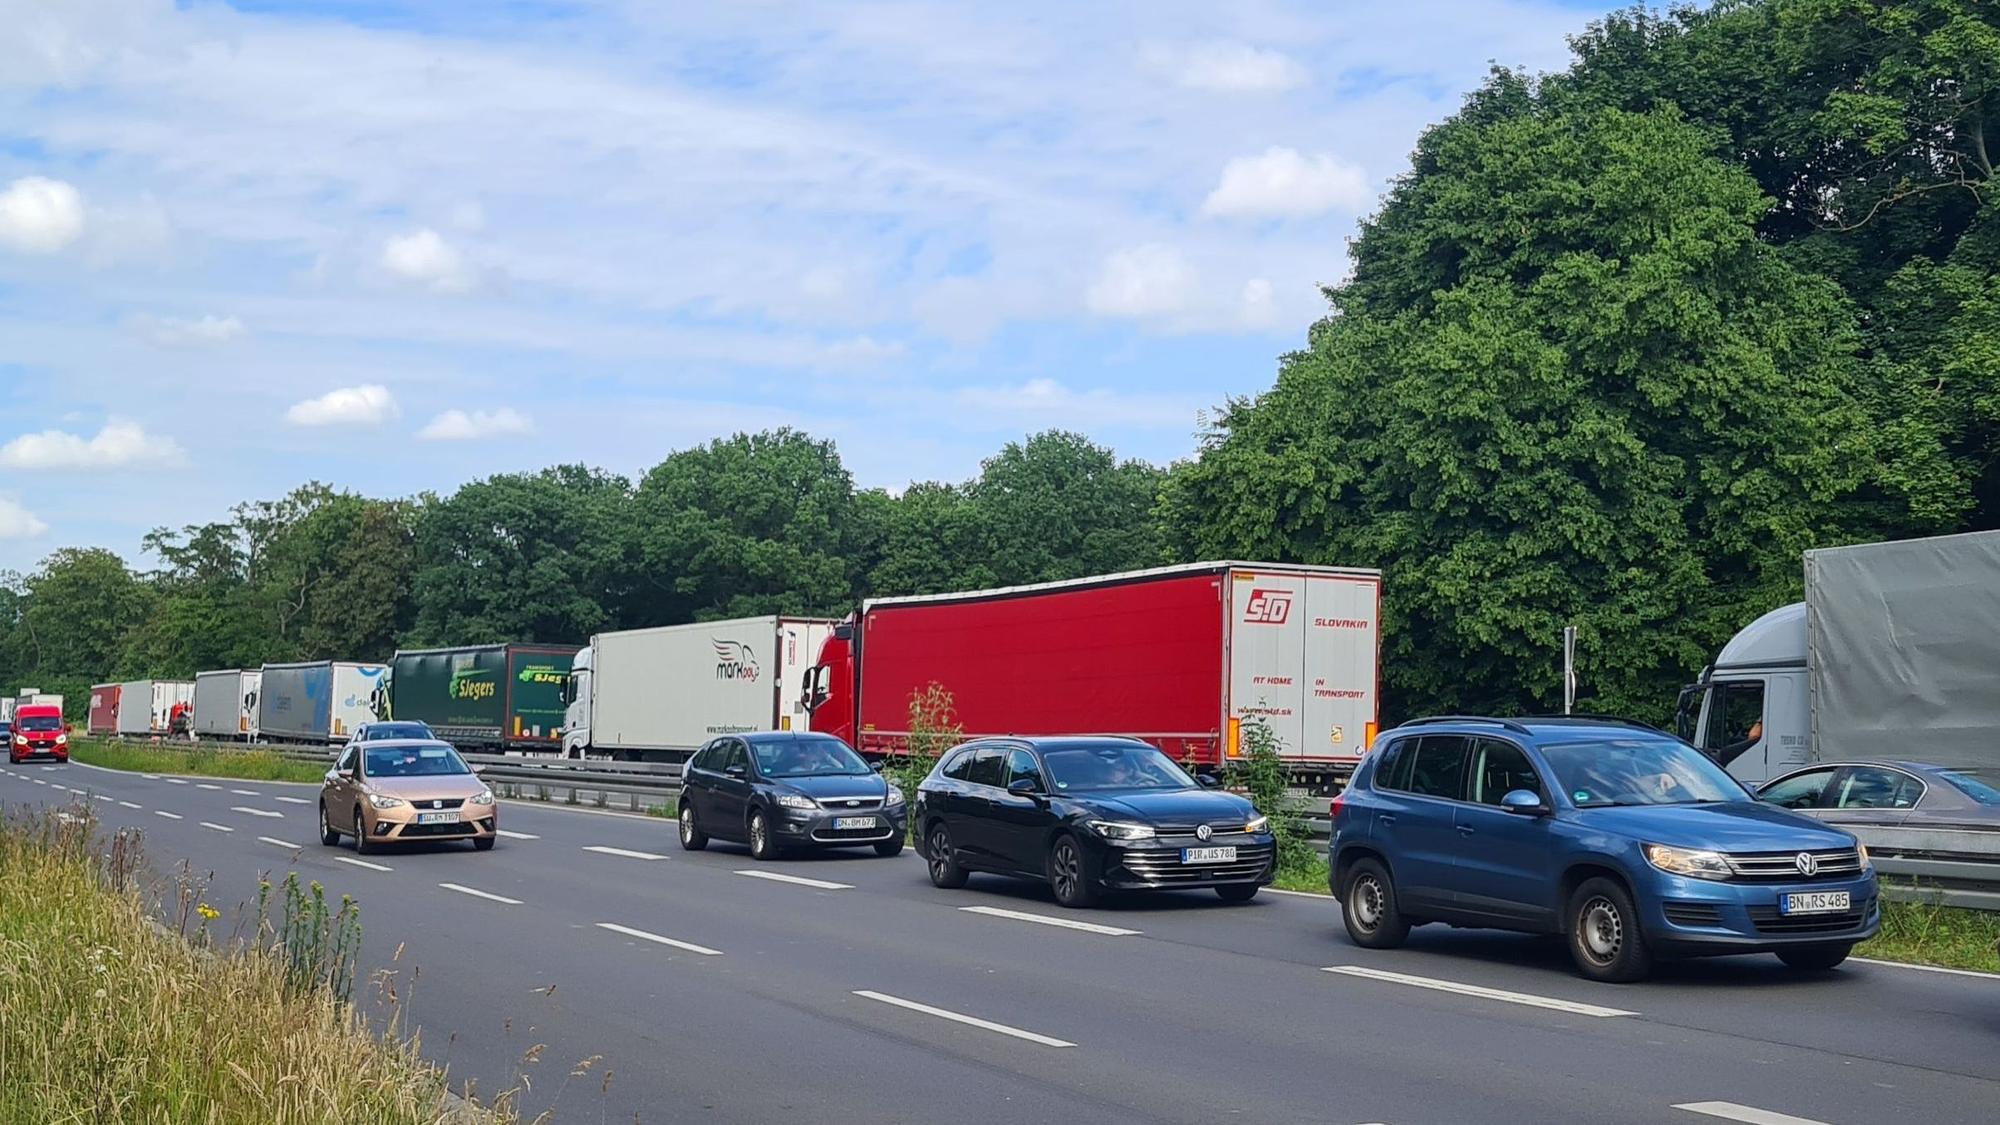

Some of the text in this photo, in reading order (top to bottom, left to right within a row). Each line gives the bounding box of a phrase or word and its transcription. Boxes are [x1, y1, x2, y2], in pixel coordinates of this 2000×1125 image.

[1314, 618, 1368, 629] SLOVAKIA
[1253, 676, 1293, 685] AT HOME
[1315, 678, 1325, 686] IN
[1314, 689, 1365, 698] TRANSPORT
[1789, 893, 1848, 909] BN RS 485
